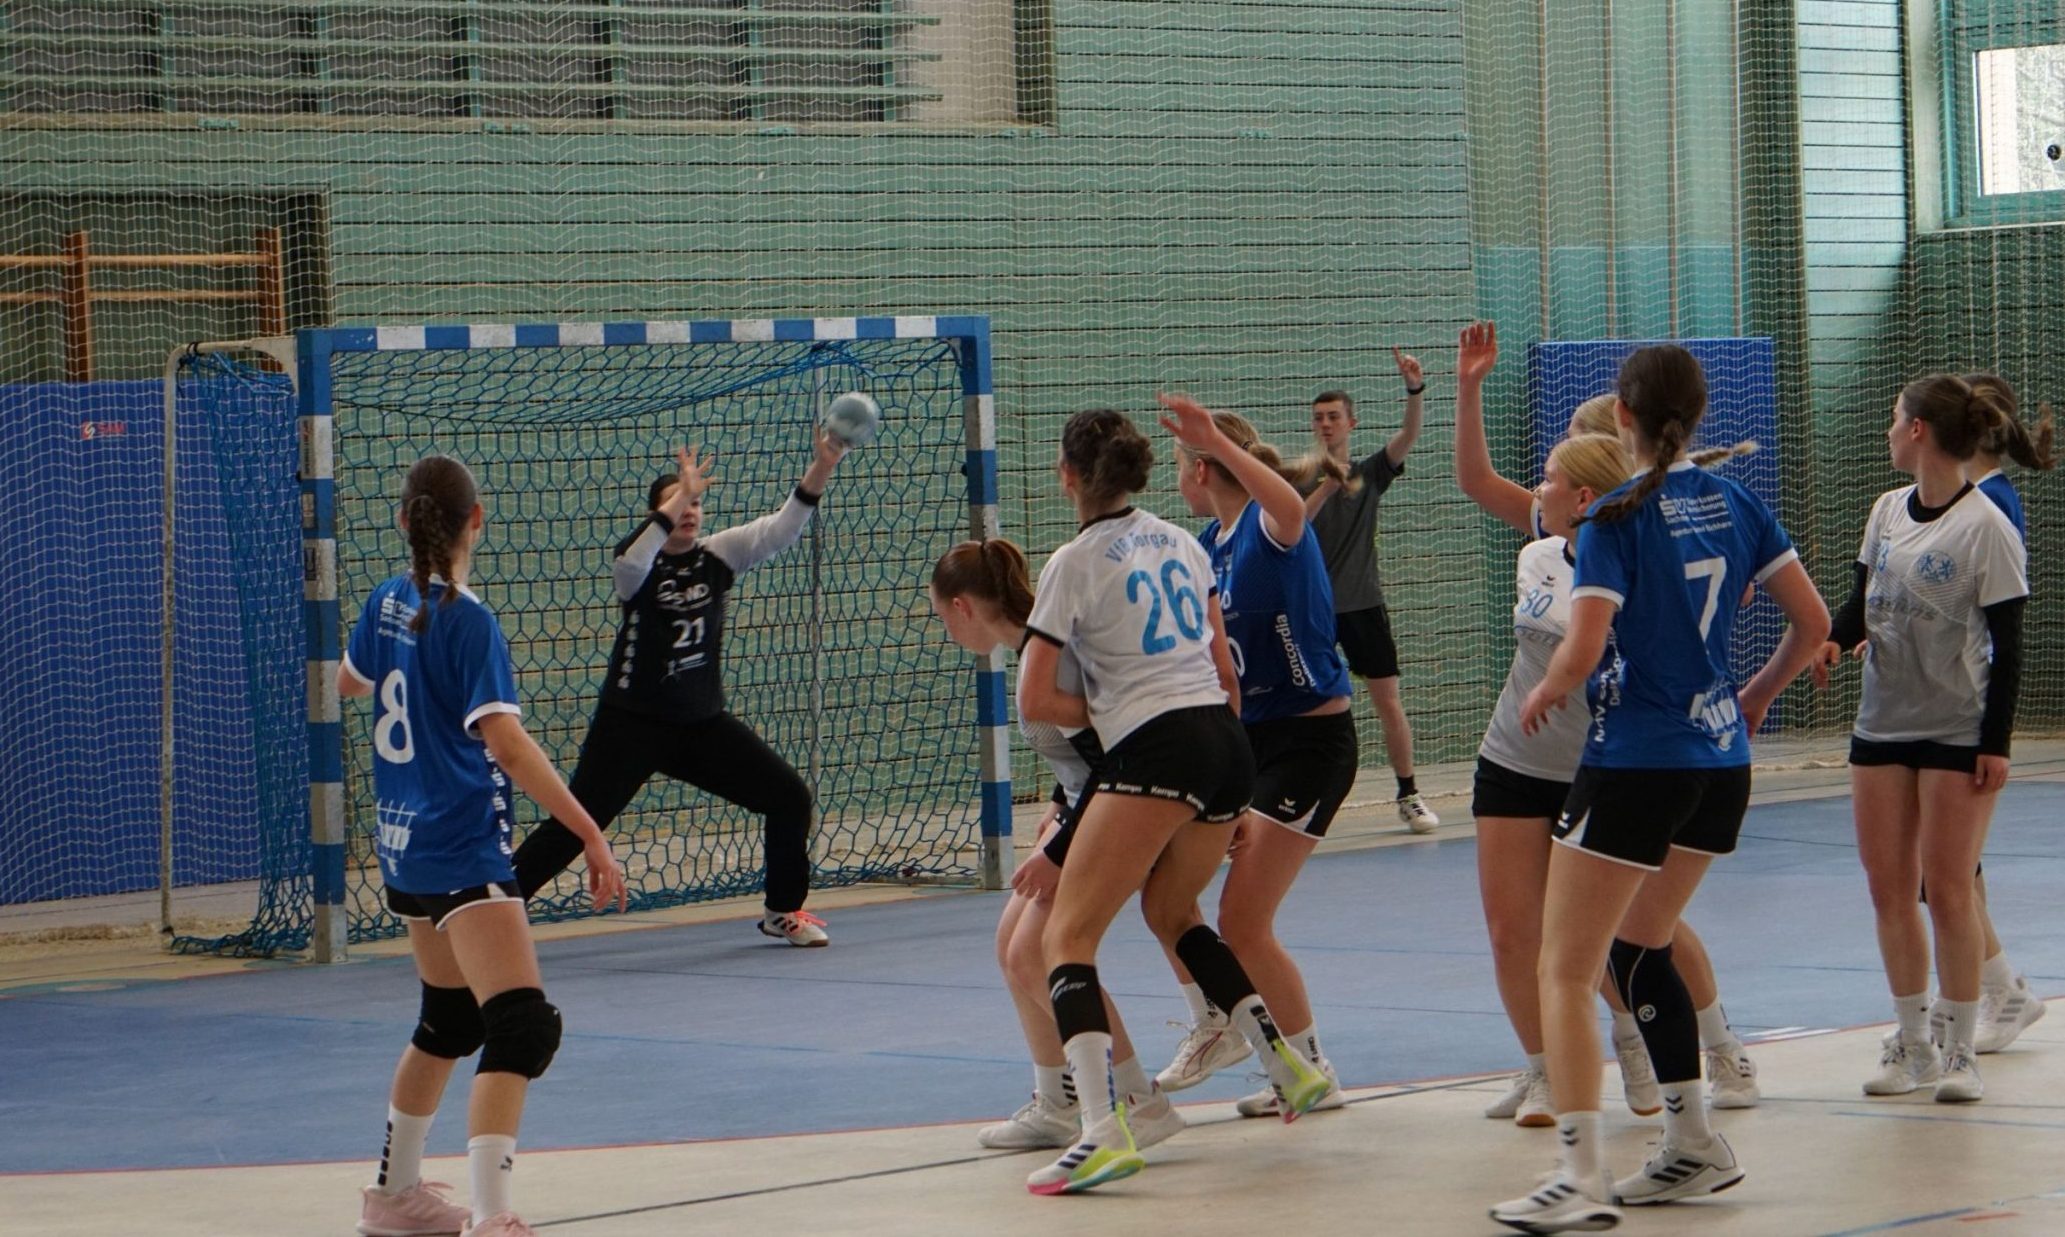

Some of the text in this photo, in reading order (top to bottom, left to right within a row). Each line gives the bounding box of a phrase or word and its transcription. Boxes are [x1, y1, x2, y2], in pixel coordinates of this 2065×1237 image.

[672, 616, 706, 649] 21
[1126, 559, 1203, 655] 26
[1684, 556, 1727, 643] 7
[1275, 614, 1306, 687] Concordia
[374, 669, 415, 764] 8
